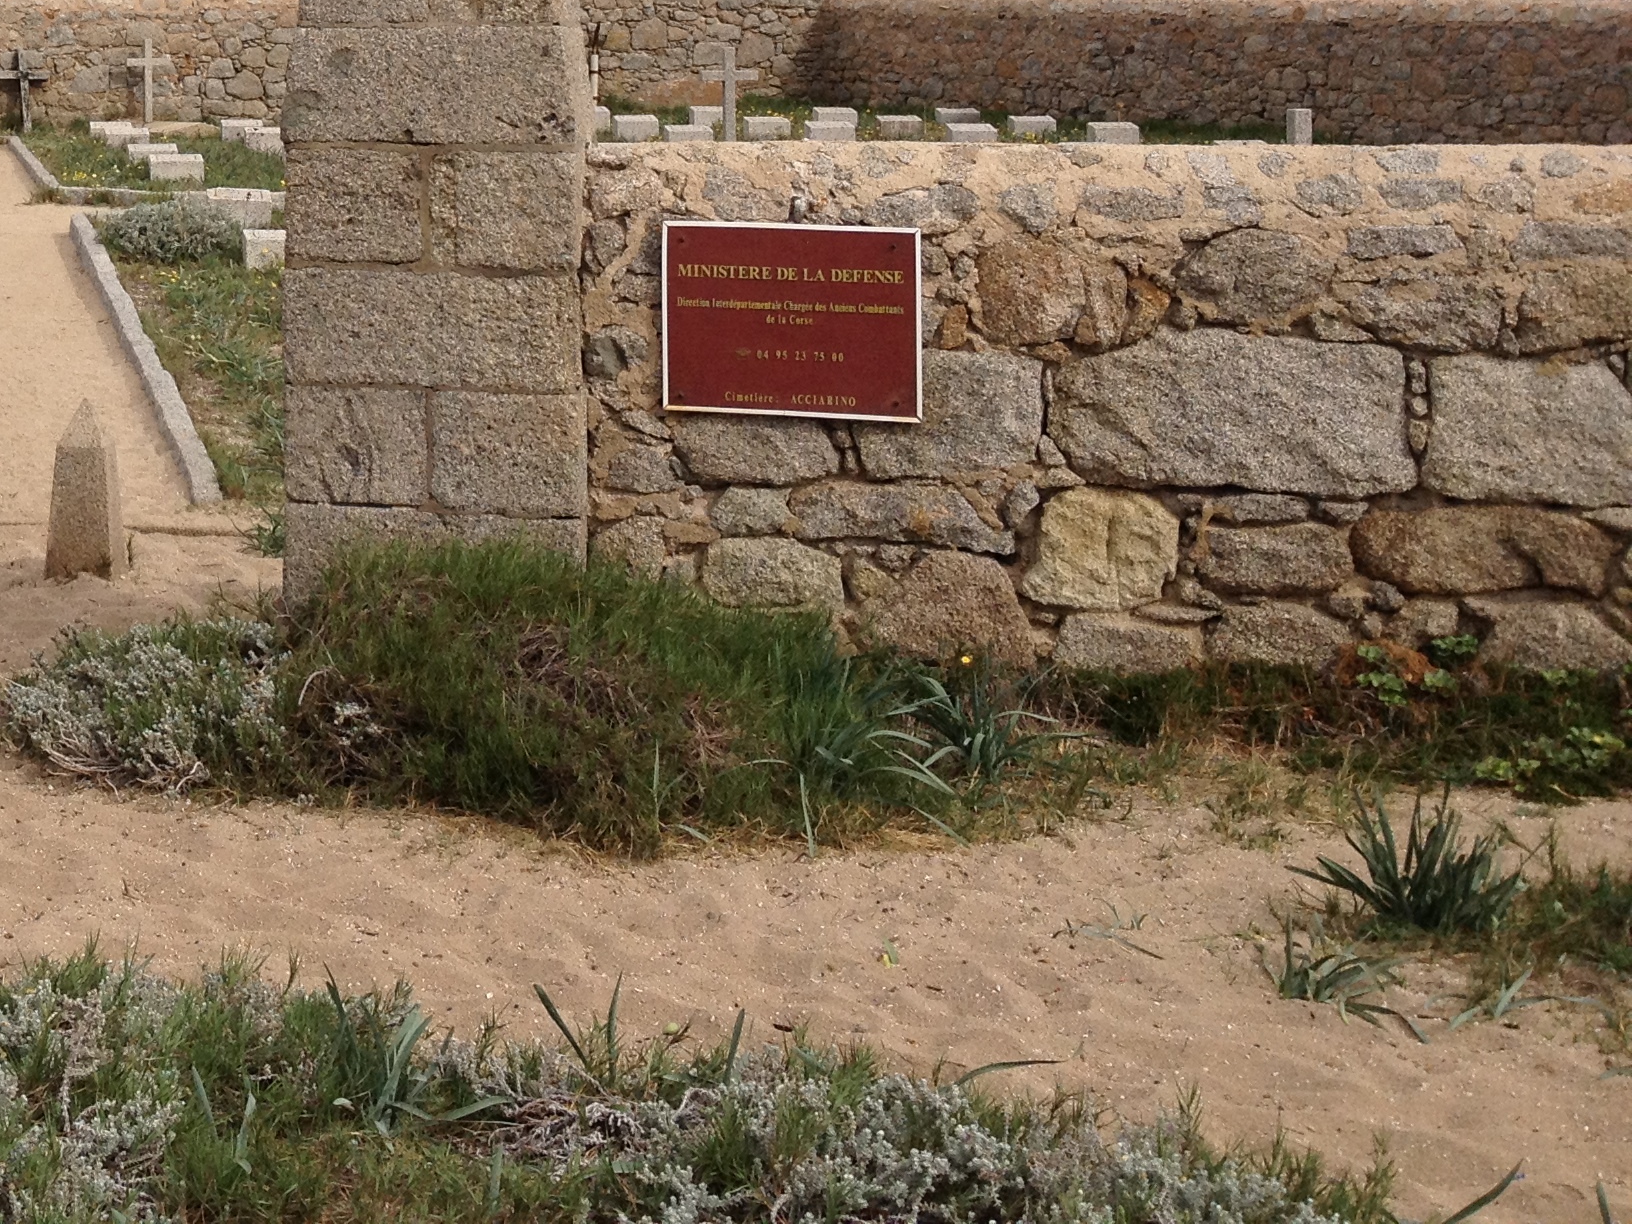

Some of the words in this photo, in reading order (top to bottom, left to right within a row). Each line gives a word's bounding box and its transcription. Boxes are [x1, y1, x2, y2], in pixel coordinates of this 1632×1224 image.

[678, 264, 772, 280] MINISTERE
[776, 267, 799, 281] DE
[803, 268, 825, 282] LA
[831, 269, 905, 284] DEFENSE
[677, 296, 710, 308] Direction
[814, 302, 827, 312] des
[829, 302, 857, 313] Anciens
[858, 303, 904, 315] Combattants
[766, 314, 776, 324] de
[778, 314, 787, 325] la
[789, 315, 814, 326] Corse
[756, 349, 769, 360] 04
[775, 350, 788, 361] 95
[794, 350, 807, 361] 23
[813, 351, 826, 362] 75
[831, 352, 845, 363] 00
[790, 393, 857, 407] ACCIARINO
